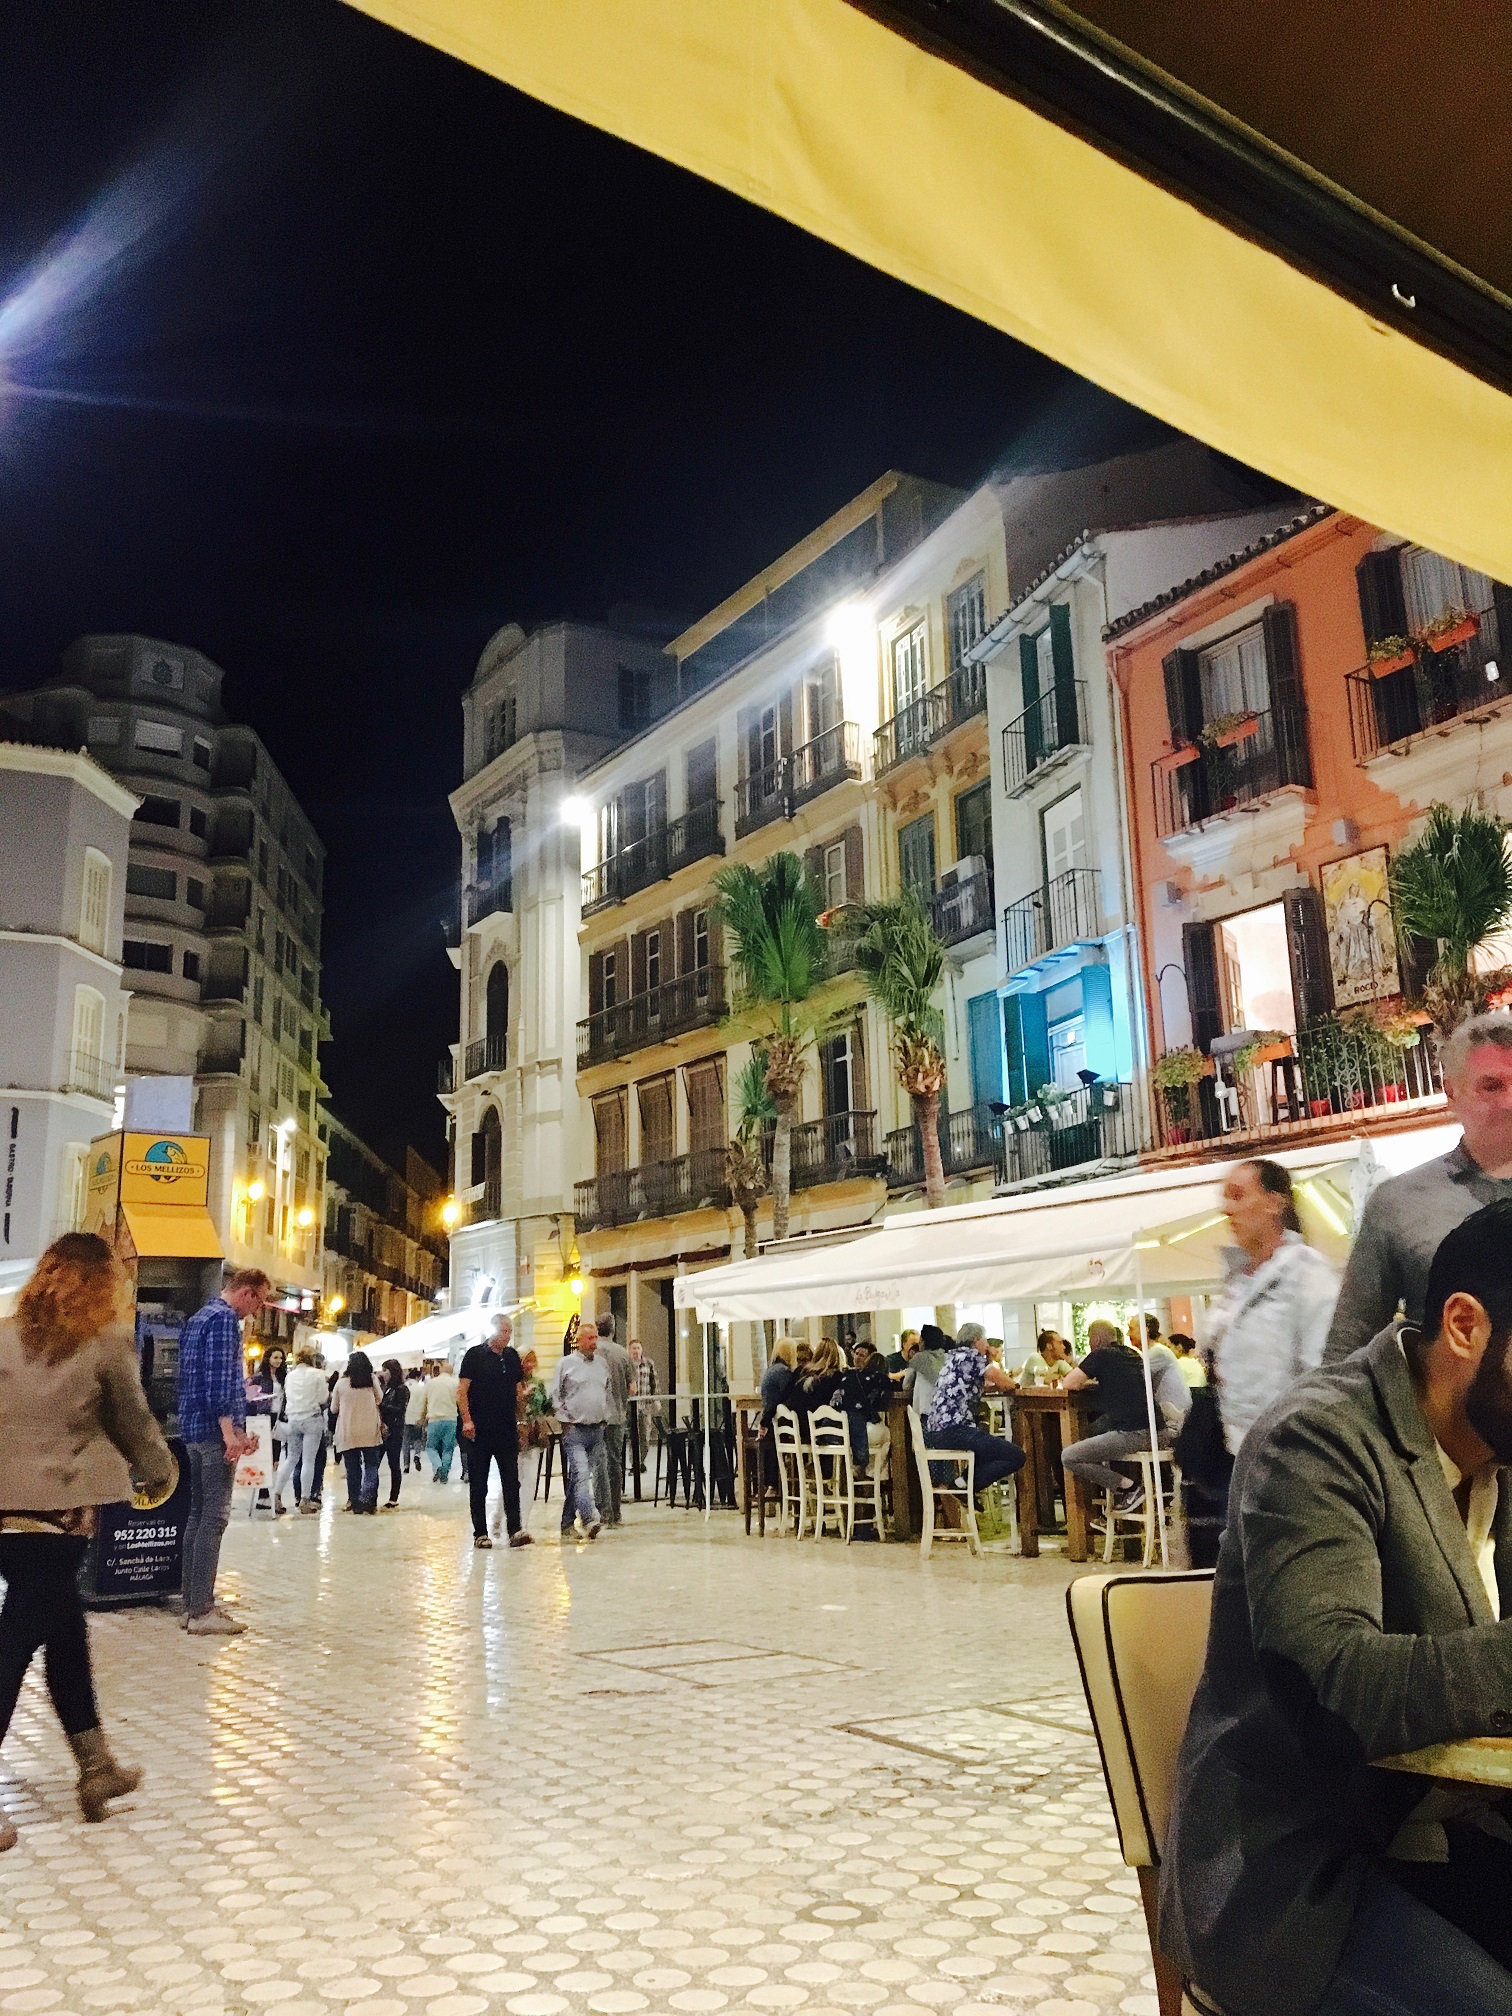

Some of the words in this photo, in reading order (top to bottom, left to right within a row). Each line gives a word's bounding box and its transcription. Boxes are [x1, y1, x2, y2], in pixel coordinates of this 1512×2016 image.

[135, 1164, 152, 1172] LOS
[155, 1165, 195, 1175] MELLIZOS
[114, 1530, 135, 1541] 952
[136, 1527, 156, 1540] 220
[157, 1525, 177, 1538] 315
